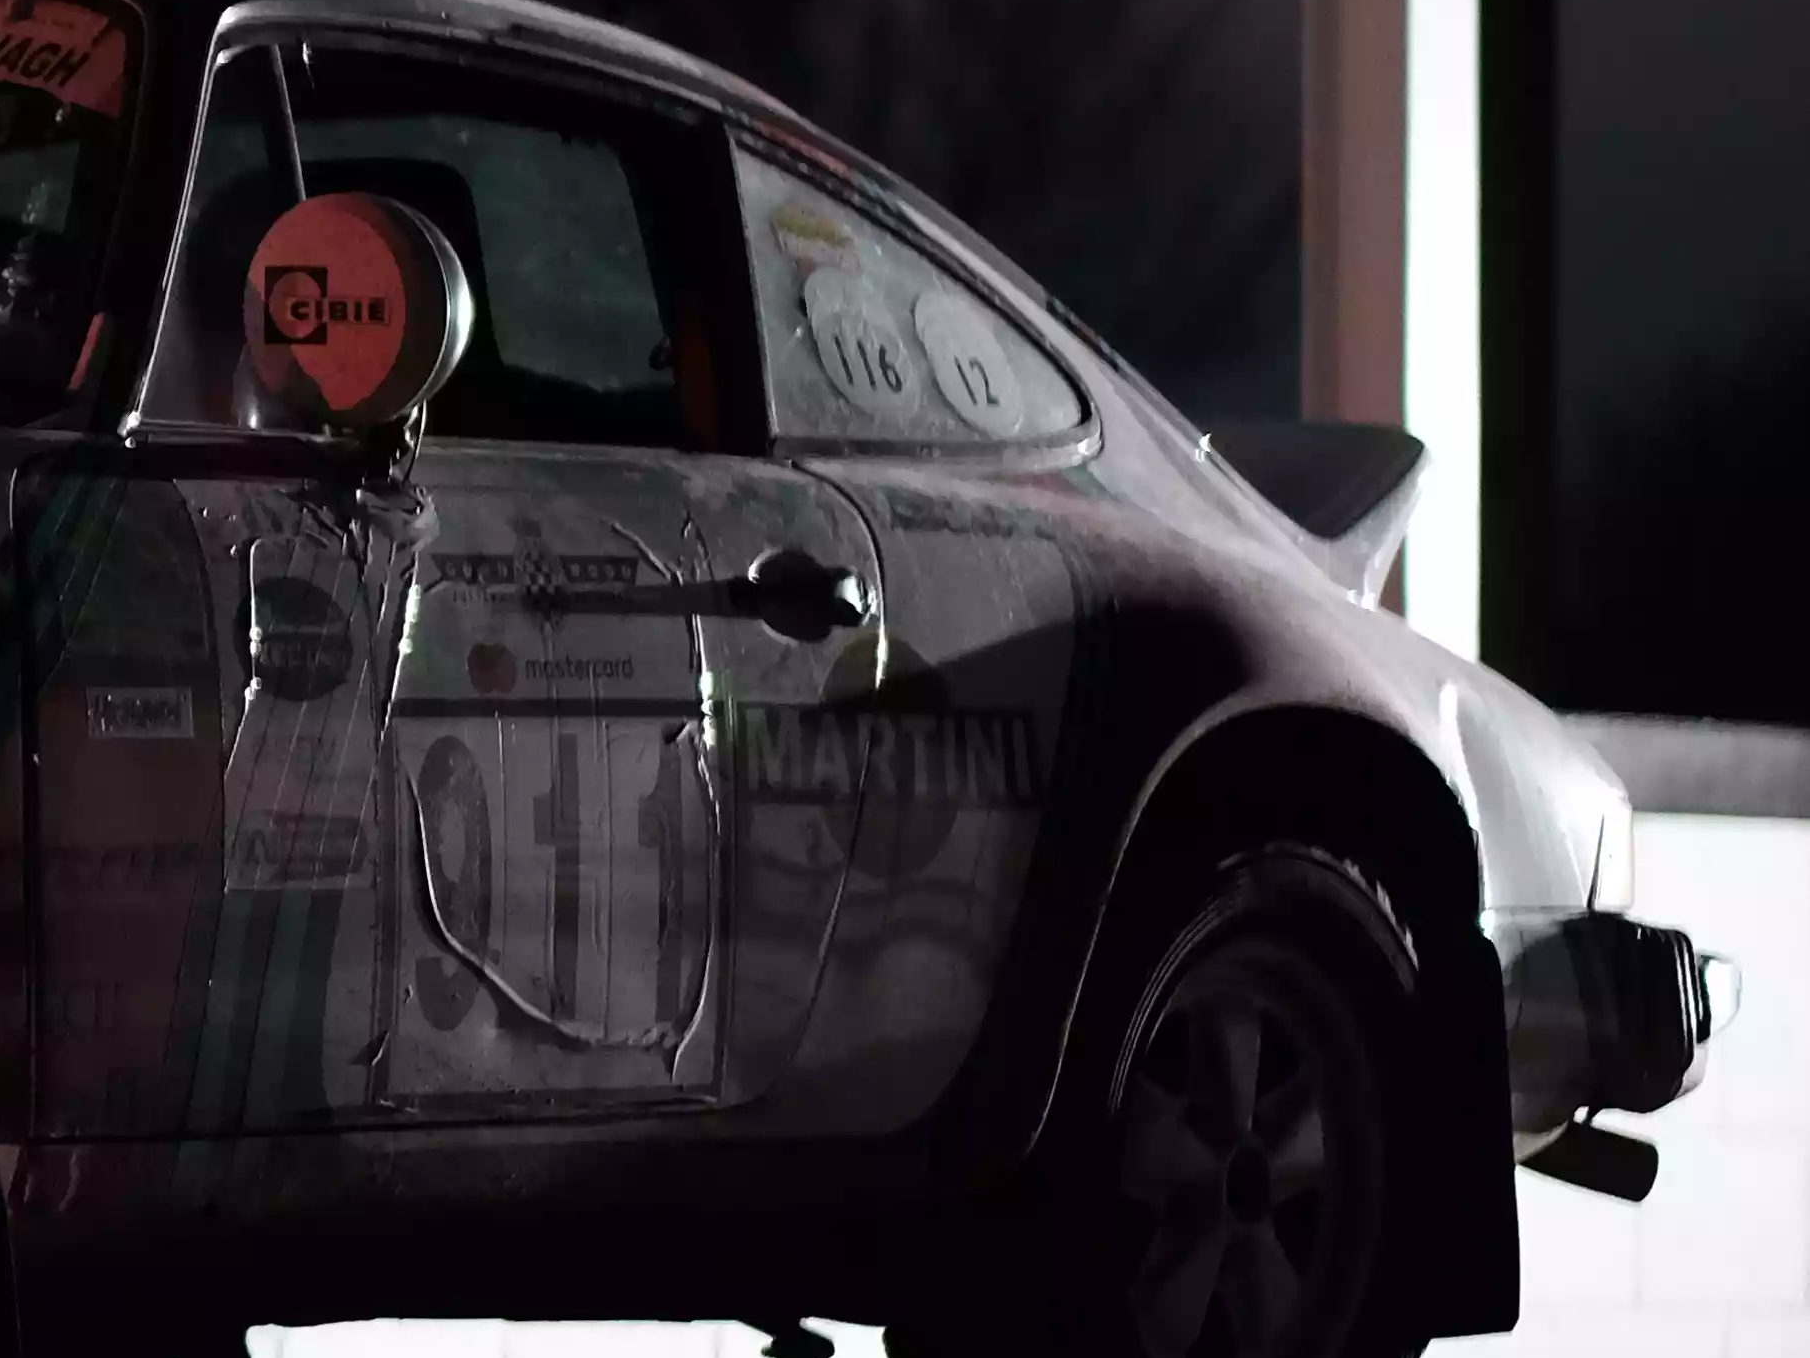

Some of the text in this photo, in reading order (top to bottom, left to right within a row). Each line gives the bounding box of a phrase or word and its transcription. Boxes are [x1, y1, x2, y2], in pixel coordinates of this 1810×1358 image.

[290, 298, 387, 324] CIBIE
[832, 335, 902, 393] 116
[953, 355, 999, 406] 12
[524, 655, 634, 680] mastercard
[744, 706, 1032, 800] MARTINI
